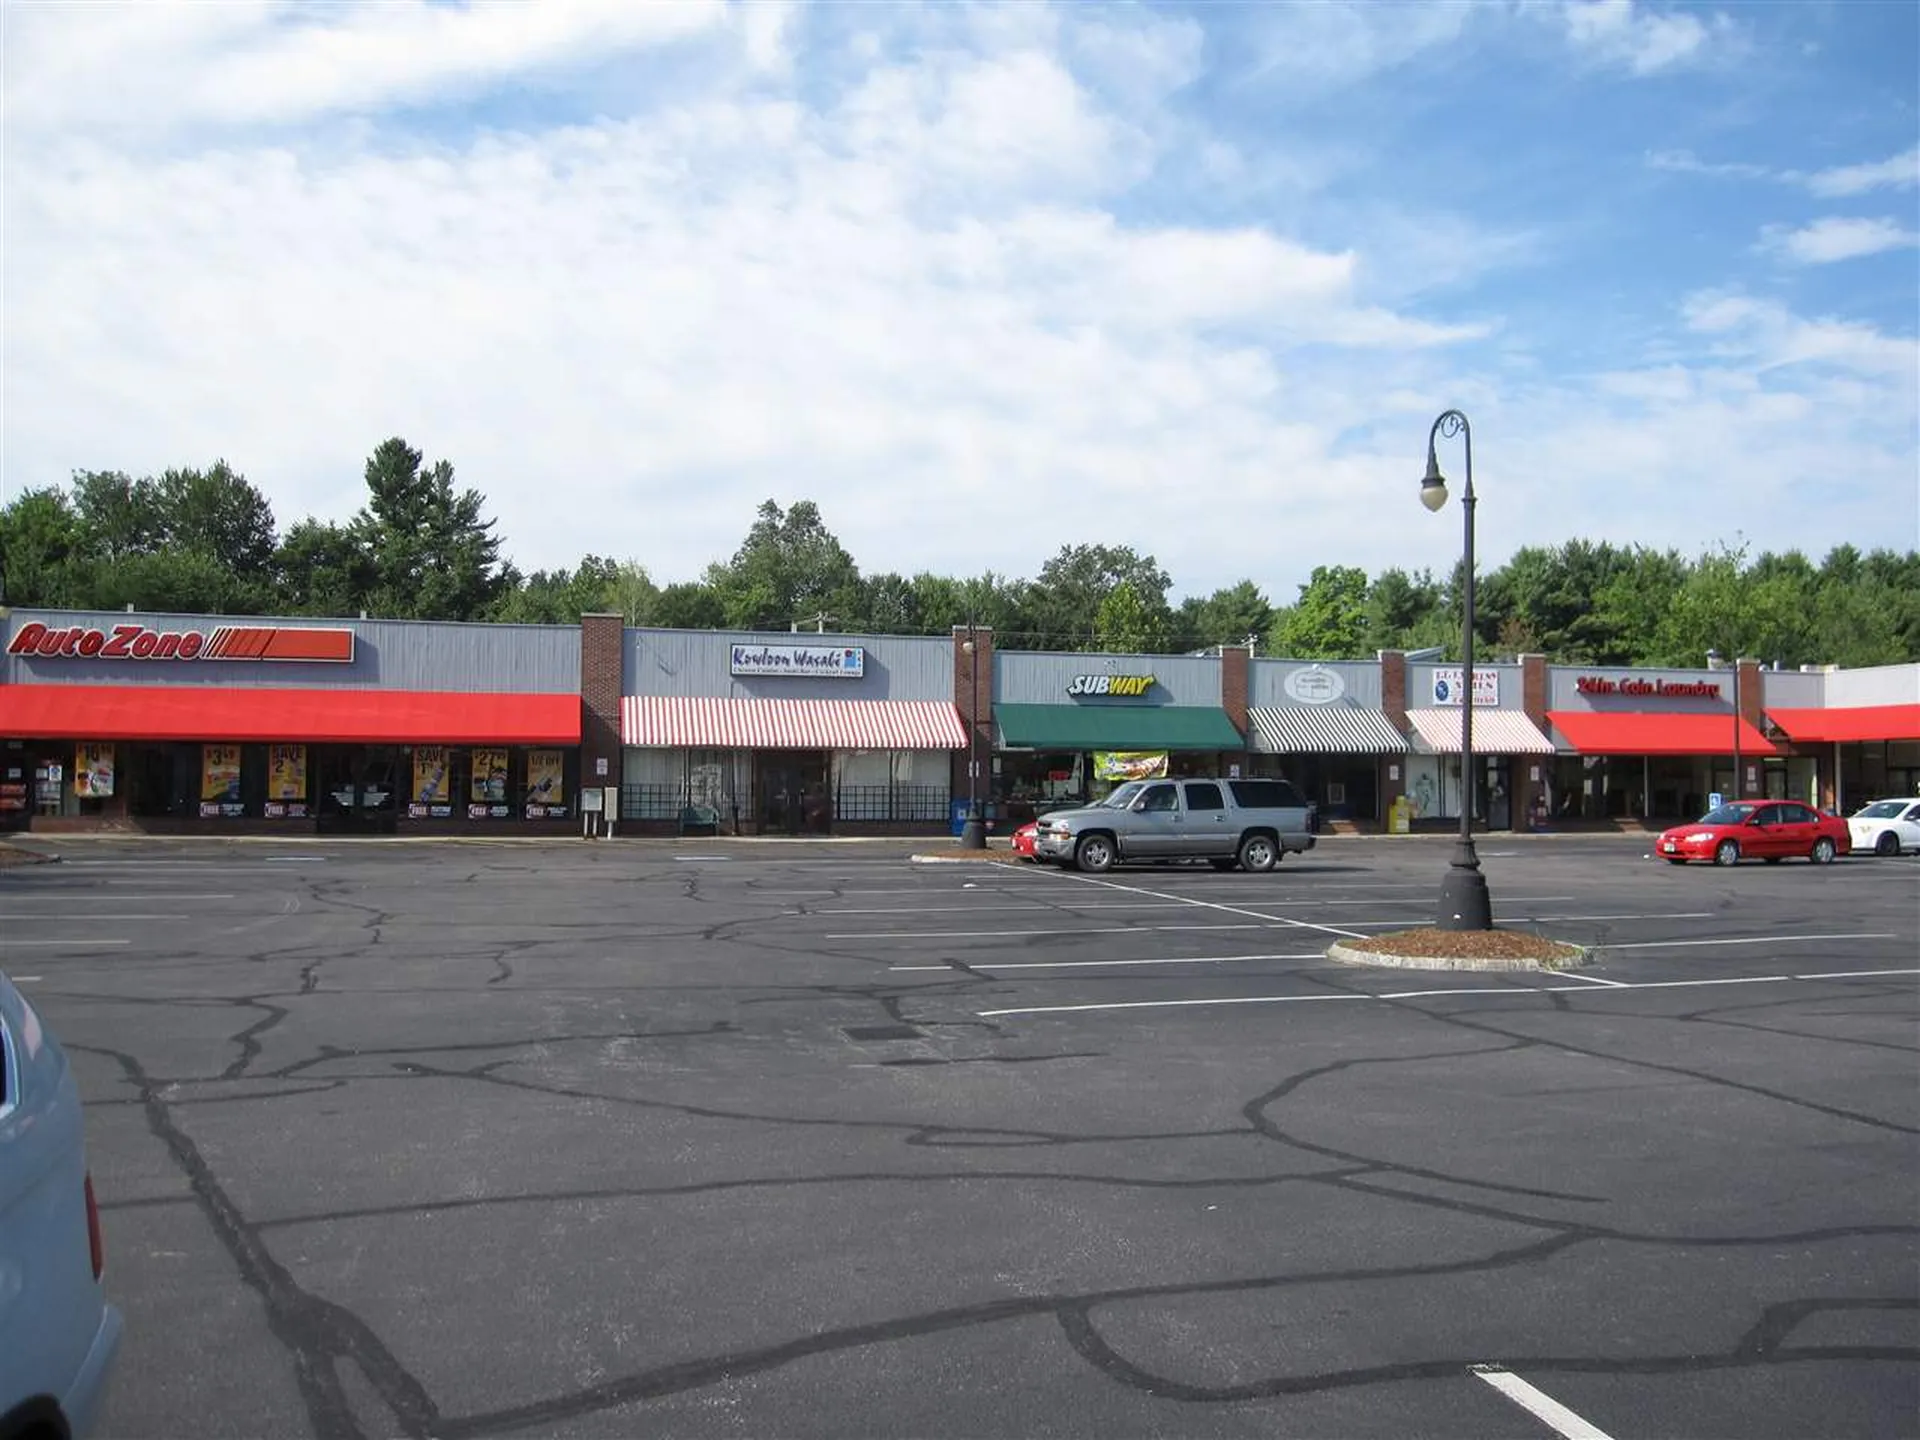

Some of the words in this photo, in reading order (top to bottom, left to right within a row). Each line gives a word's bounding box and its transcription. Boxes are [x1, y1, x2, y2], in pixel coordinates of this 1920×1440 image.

[7, 621, 204, 660] AutoZone
[733, 647, 791, 666] Kowloon
[793, 649, 841, 668] Wasabi
[1068, 674, 1154, 696] SUBWAY
[1619, 677, 1653, 695] Coin
[1656, 678, 1721, 699] Laundry
